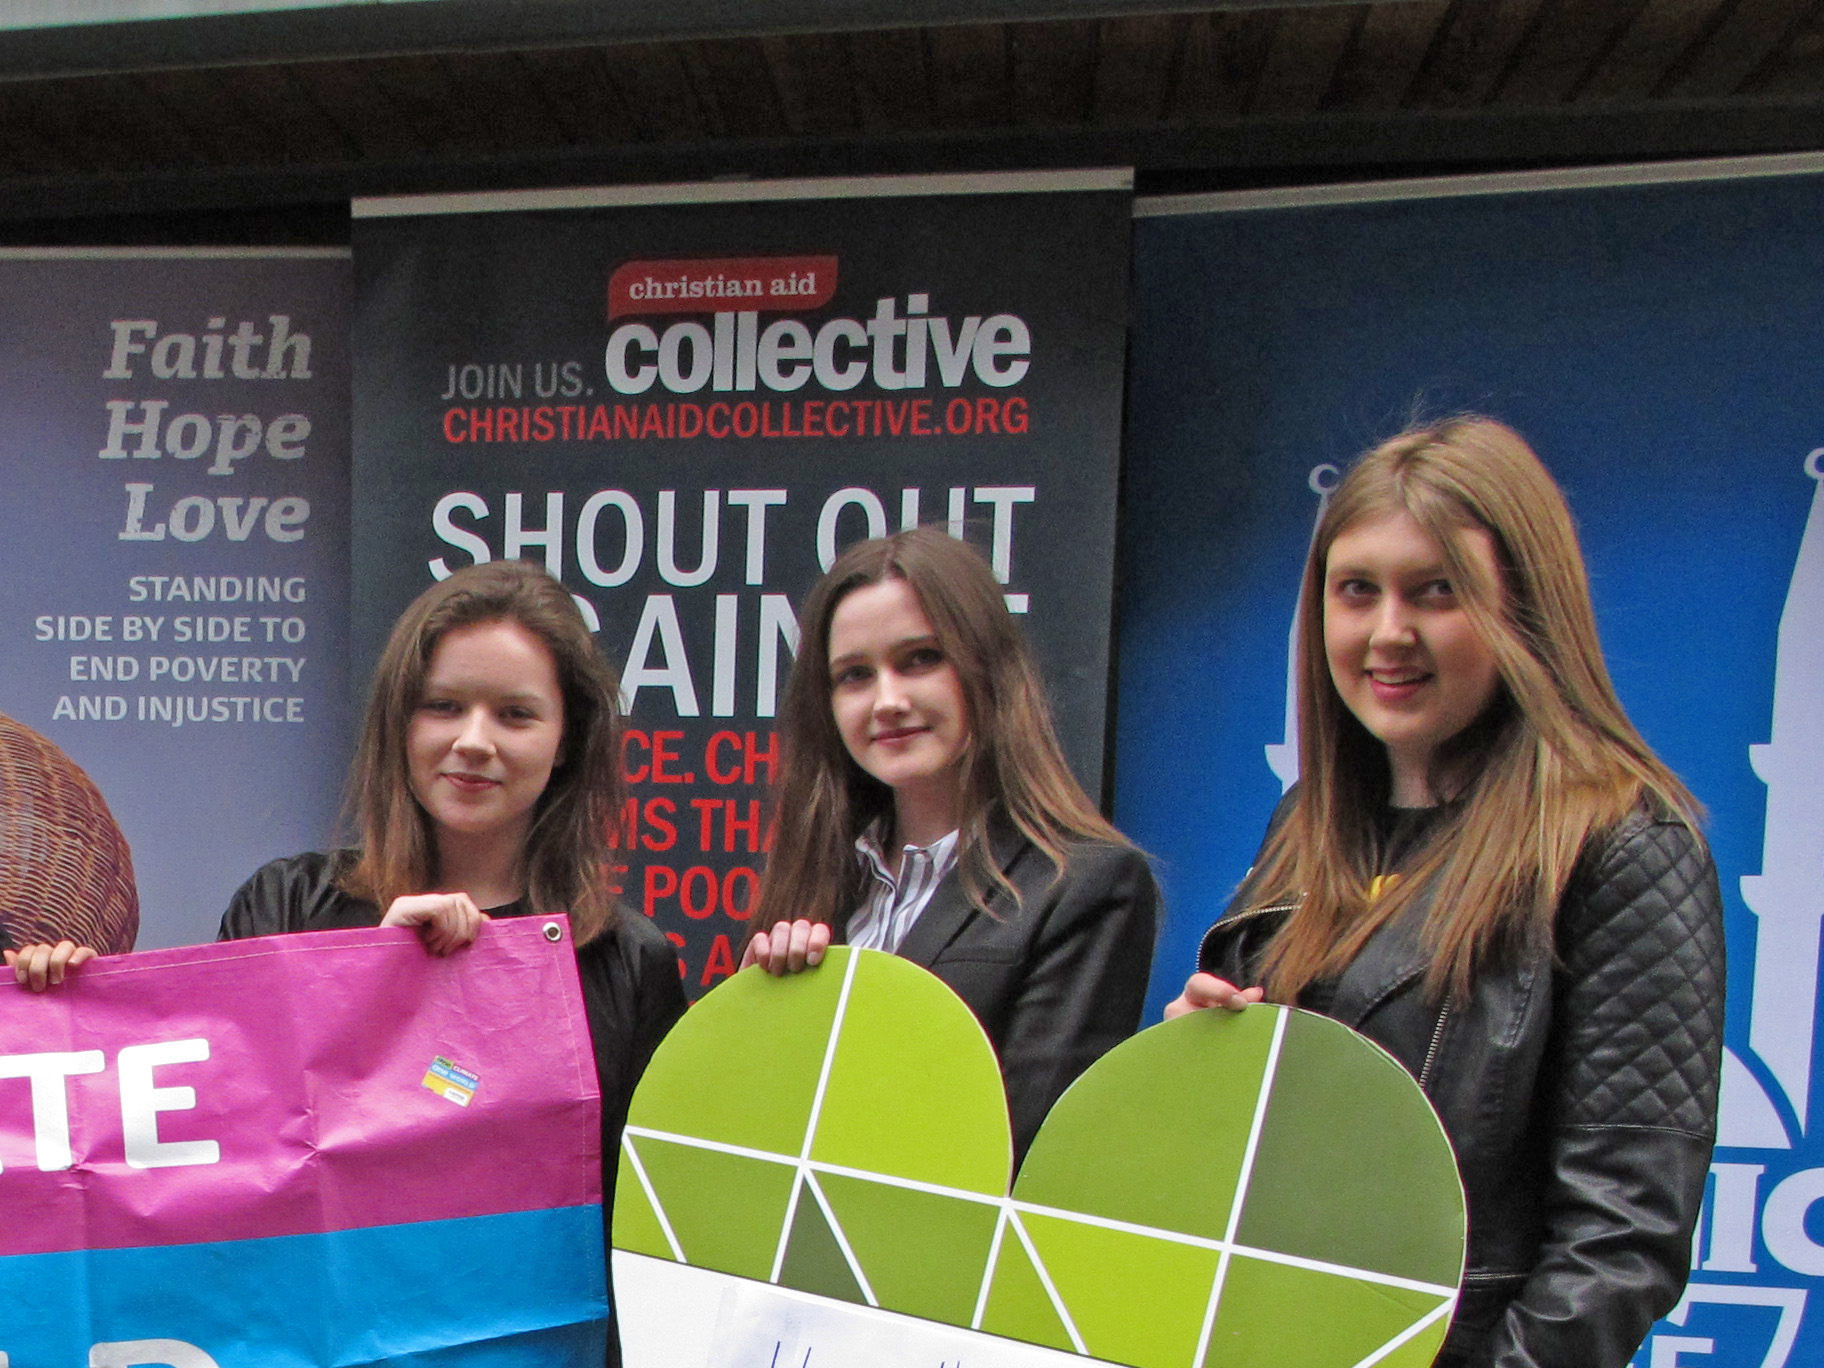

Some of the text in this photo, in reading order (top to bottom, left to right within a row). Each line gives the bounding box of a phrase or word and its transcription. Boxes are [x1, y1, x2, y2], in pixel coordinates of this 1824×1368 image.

[628, 272, 817, 301] christian aid
[102, 314, 313, 380] Faith
[604, 293, 1031, 395] collective
[441, 361, 594, 399] JOIN US.
[98, 399, 312, 476] Hope
[442, 397, 1029, 443] CHRISTIANAIDCOLLECTIVE.ORG
[118, 482, 312, 543] Love
[427, 489, 788, 588] SHOUT
[129, 576, 306, 603] STANDING
[35, 615, 306, 643] SIDE BY SIDE TO
[70, 656, 306, 682] END POVERTY
[52, 695, 304, 728] AND INJUSTICE
